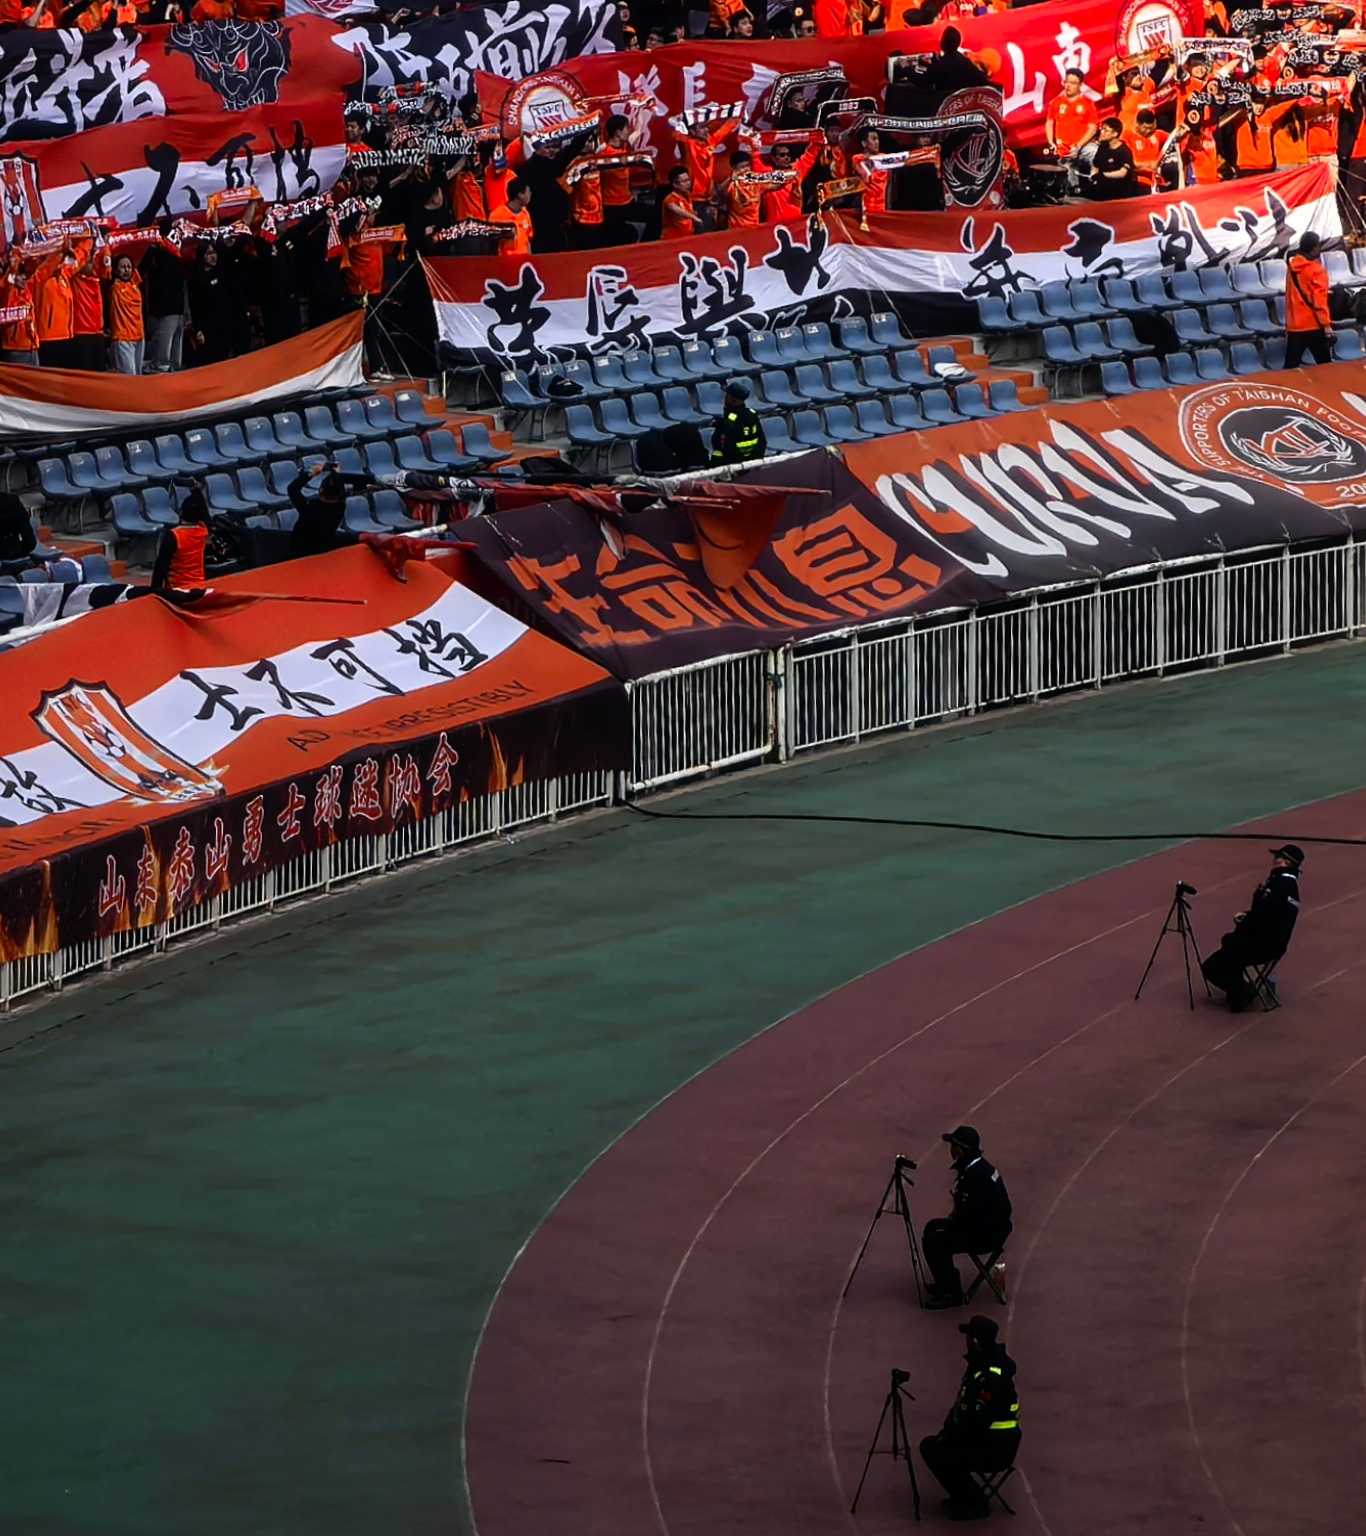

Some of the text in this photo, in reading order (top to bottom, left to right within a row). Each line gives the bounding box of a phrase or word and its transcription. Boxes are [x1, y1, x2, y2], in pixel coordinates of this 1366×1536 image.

[1235, 388, 1311, 409] TAISHAN
[98, 732, 460, 919] 山东泰山勇士球迷协会
